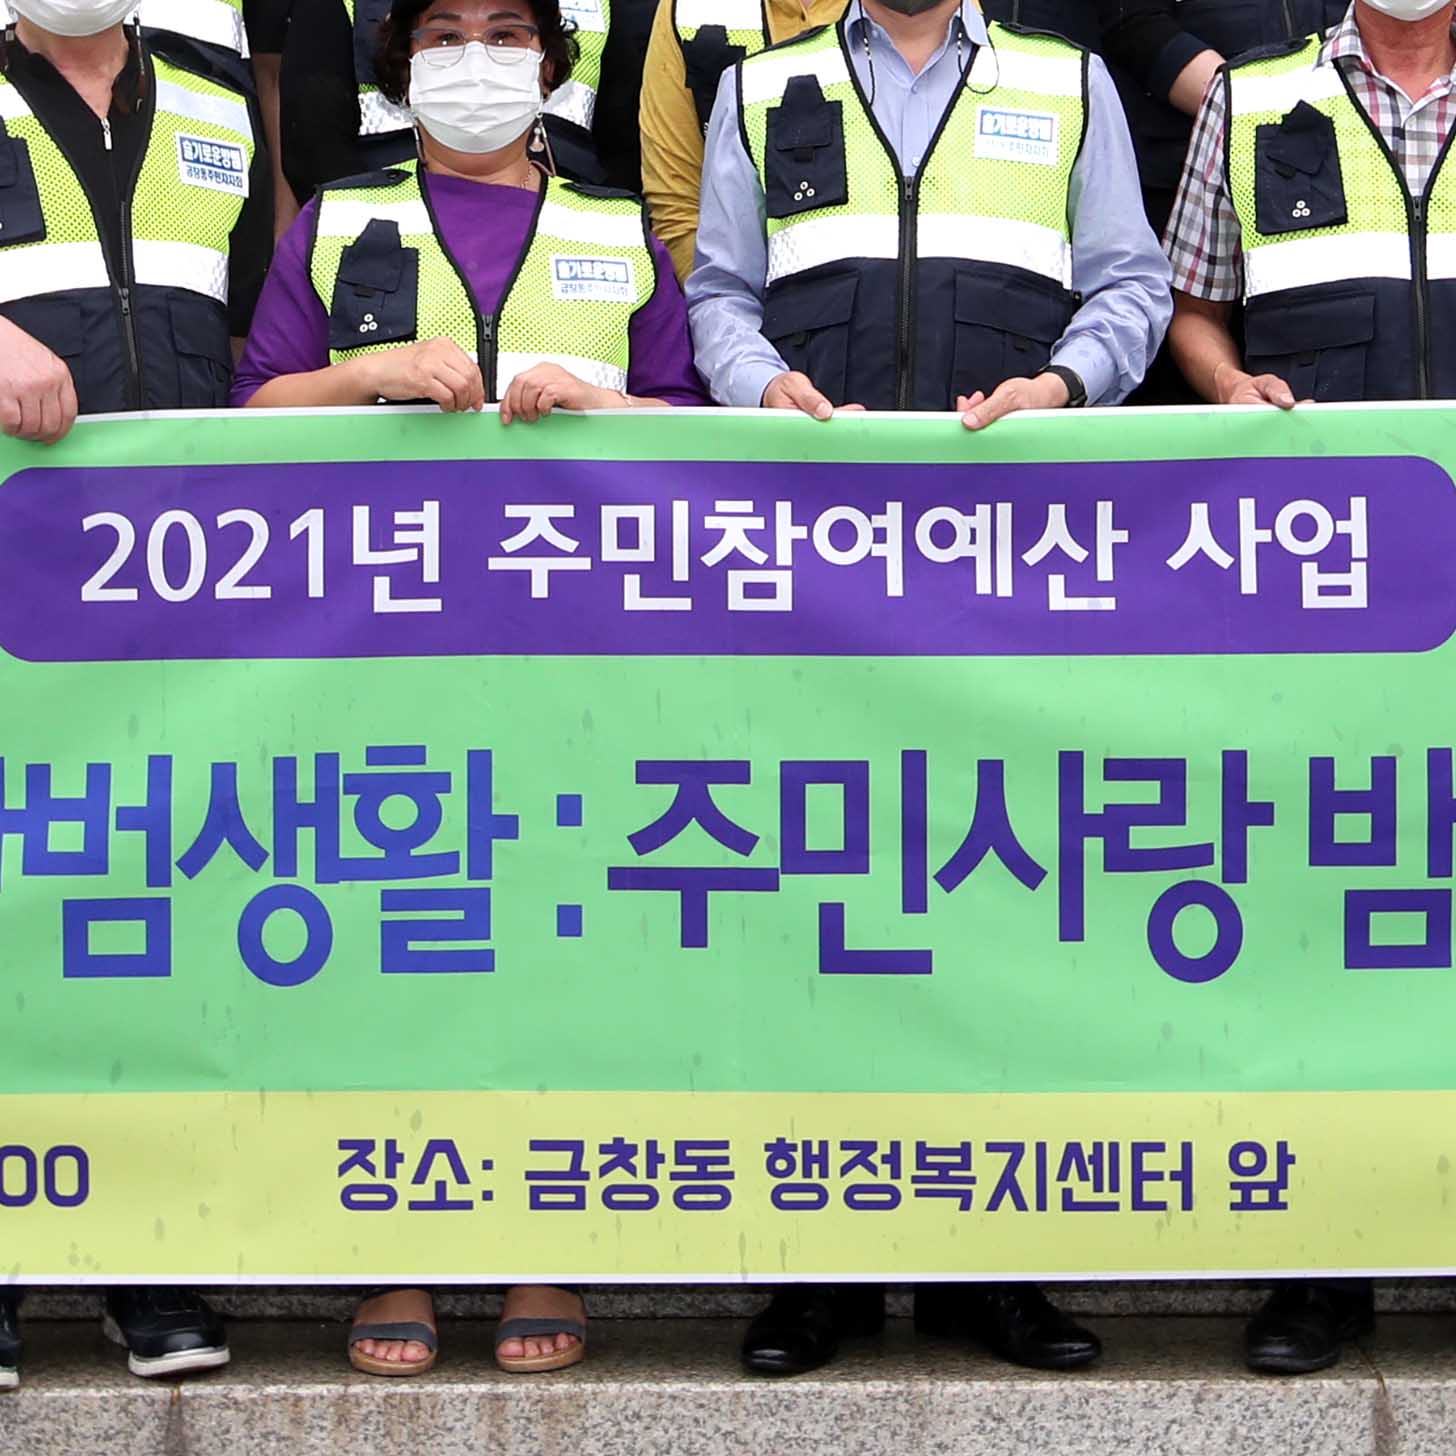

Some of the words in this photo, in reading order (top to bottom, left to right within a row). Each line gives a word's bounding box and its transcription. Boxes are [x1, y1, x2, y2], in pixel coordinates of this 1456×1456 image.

[80, 500, 443, 614] 2021년
[487, 499, 1130, 612] 주민참여예산
[1165, 495, 1369, 610] 사업
[338, 1138, 494, 1212] 장소:
[525, 1137, 735, 1212] 금창동
[765, 1138, 1194, 1213] 행정복지센터
[1230, 1140, 1297, 1212] 앞
